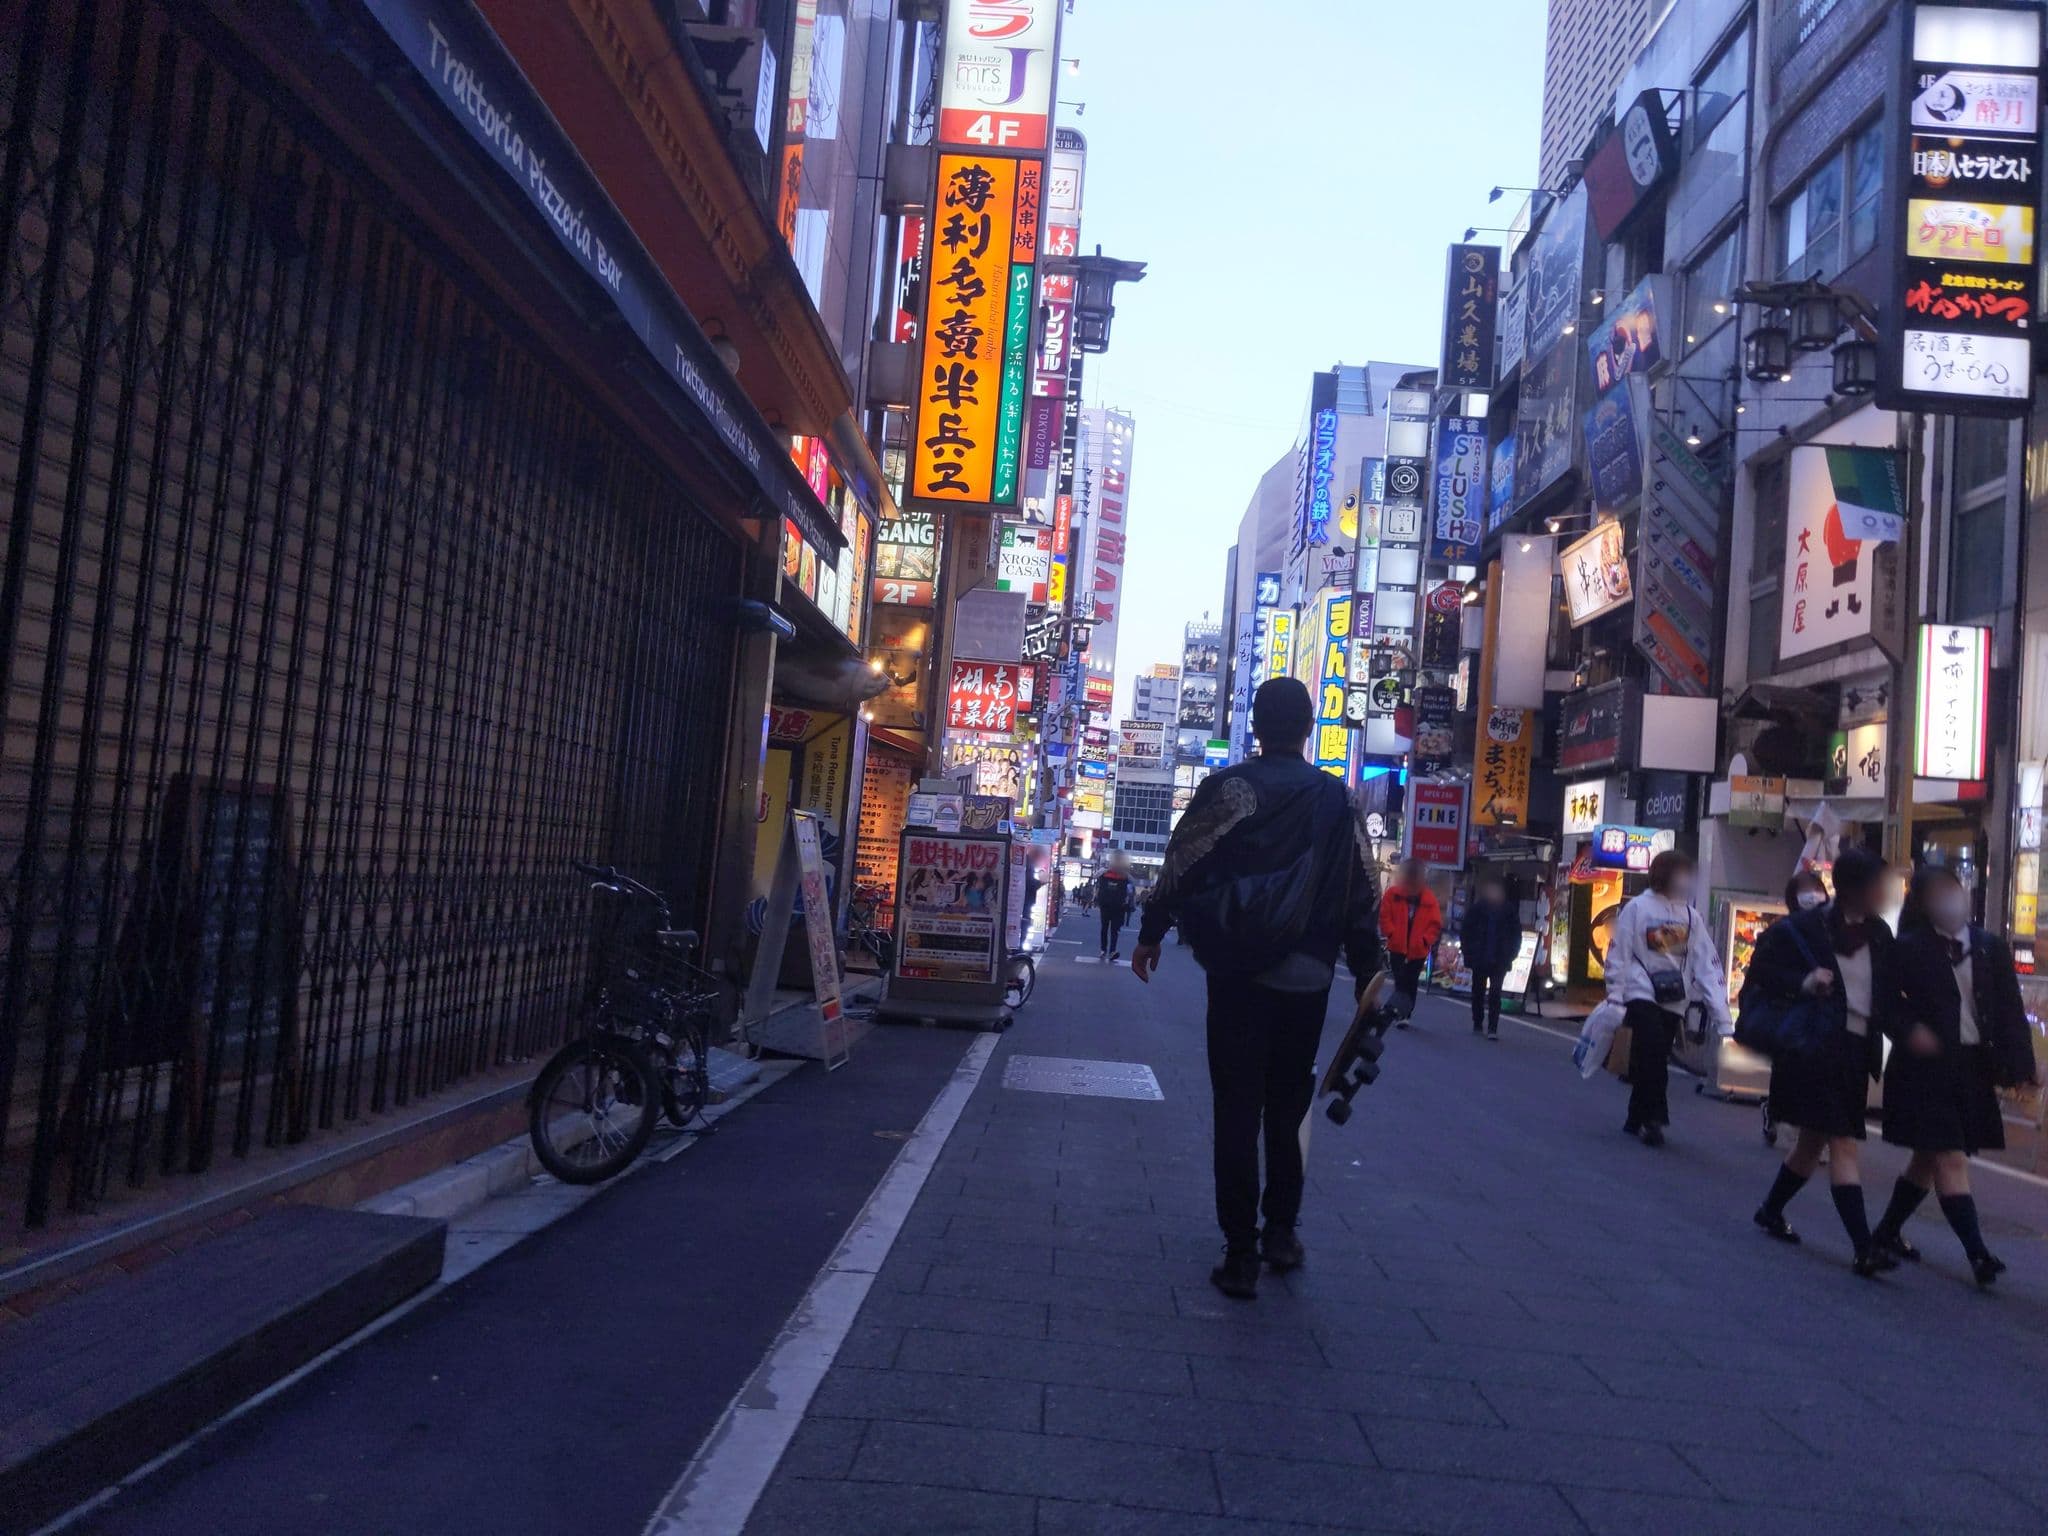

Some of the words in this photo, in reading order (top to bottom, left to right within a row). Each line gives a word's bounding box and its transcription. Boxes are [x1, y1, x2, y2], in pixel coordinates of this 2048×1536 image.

[428, 19, 524, 171] Trattoria
[1976, 98, 2023, 125] 酔月
[966, 114, 1021, 146] 4F
[1913, 151, 2032, 183] 日本人セラピスト
[1918, 222, 2004, 247] クアトロ
[1448, 418, 1480, 433] 麻雀
[1309, 410, 1337, 544] カラオケの鉄人
[878, 520, 935, 545] GANG
[1001, 552, 1048, 567] XROSS
[1005, 564, 1042, 578] CASA
[882, 582, 918, 604] 2F
[1792, 527, 1812, 635] 大原屋
[952, 664, 1014, 699] 湖南
[964, 701, 1011, 732] 菜館
[830, 736, 841, 760] Tuna
[1425, 761, 1441, 772] 2F
[823, 761, 839, 820] Restaurant
[1417, 806, 1457, 825] FINE
[1570, 791, 1599, 822] すみ家
